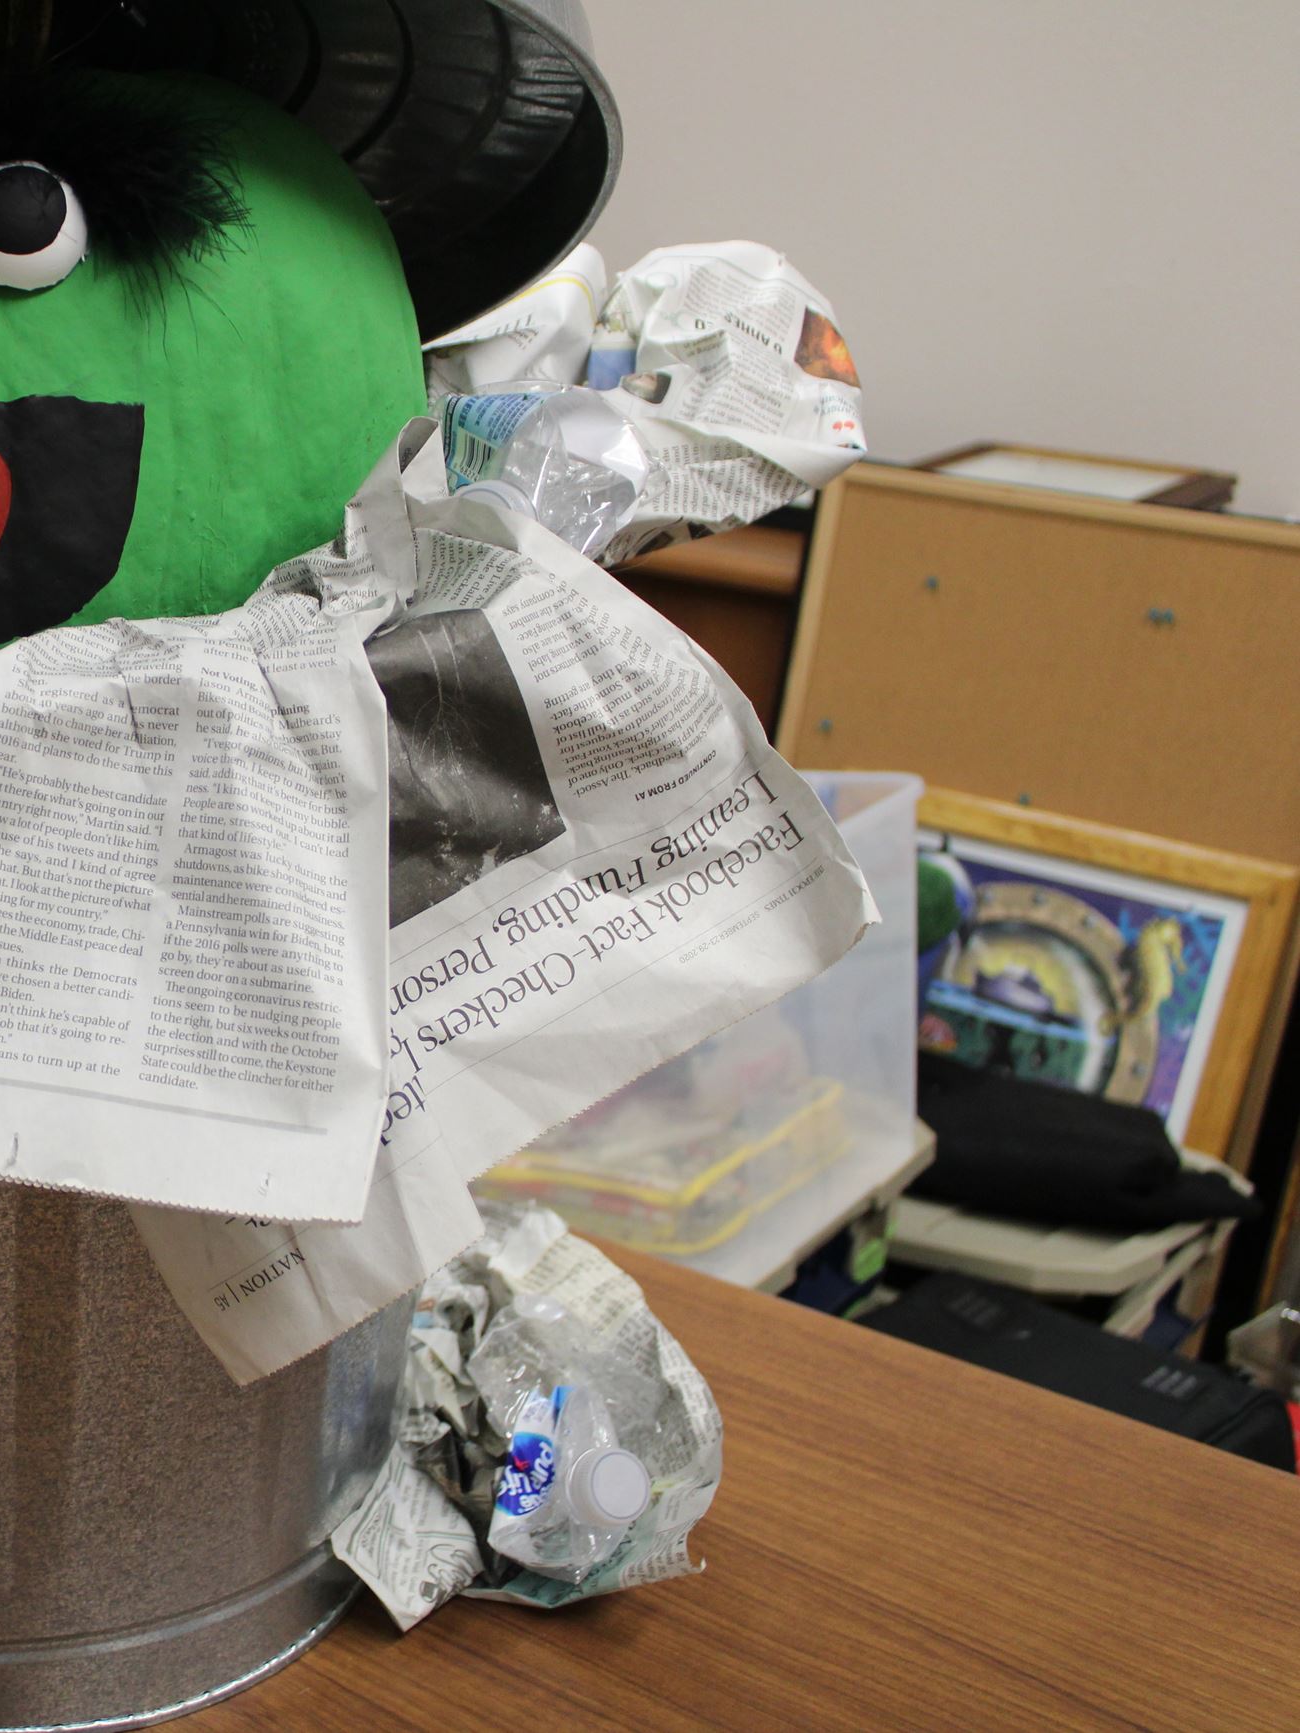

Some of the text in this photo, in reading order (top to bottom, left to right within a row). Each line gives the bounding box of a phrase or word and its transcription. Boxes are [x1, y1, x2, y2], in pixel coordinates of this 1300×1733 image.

[544, 686, 578, 709] getting
[556, 735, 567, 747] of
[568, 731, 586, 743] list
[589, 744, 612, 757] Your
[562, 752, 587, 766] Fact.
[567, 760, 624, 789] Only one of
[574, 779, 610, 798] Associ-
[609, 769, 631, 782] The
[634, 750, 717, 802] CONTINUED FROM A1
[650, 770, 779, 871] Leaning
[184, 841, 347, 887] Armagost was lucky during the
[492, 855, 649, 948] Funding,
[764, 892, 790, 912] TIMES
[416, 812, 806, 1054] Facebook Fact-Checkers
[721, 911, 761, 942] SEPTEMBER
[4, 953, 47, 972] thinks
[49, 961, 70, 976] the
[73, 965, 137, 986] Democrats
[679, 948, 698, 964] 2020
[0, 984, 33, 1002] Biden.
[10, 970, 52, 988] chosen
[52, 981, 60, 990] a
[62, 979, 95, 995] better
[97, 986, 133, 999] candi-
[164, 978, 340, 1013] The ongoing coronavirus restric-
[150, 1007, 339, 1045] to the right, but six weeks out from
[153, 994, 341, 1031] tions seem to be nudging people
[147, 1022, 337, 1060] the election and with the October
[22, 1049, 33, 1062] to
[37, 1051, 62, 1067] turn
[66, 1059, 81, 1073] up
[85, 1059, 97, 1071] at
[100, 1061, 120, 1076] the
[141, 1053, 332, 1092] State could be the clincher for either
[144, 1042, 335, 1077] surprises still to come, the Keystone
[138, 1071, 196, 1089] candidate.
[213, 1248, 306, 1312] NATION A5
